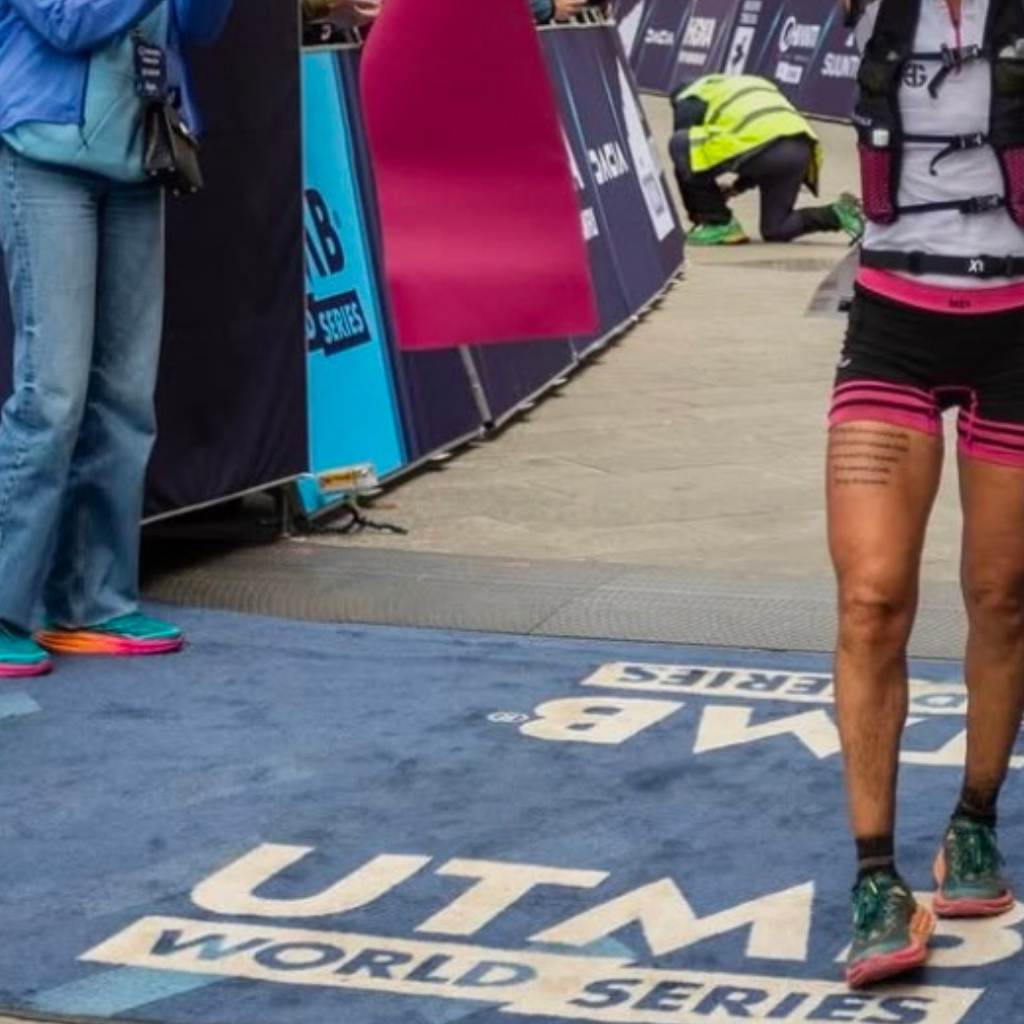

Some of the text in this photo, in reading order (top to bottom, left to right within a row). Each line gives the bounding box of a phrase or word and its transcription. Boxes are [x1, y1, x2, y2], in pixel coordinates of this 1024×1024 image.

[318, 302, 365, 346] SERIES
[149, 929, 932, 1023] WORLD SERIES
